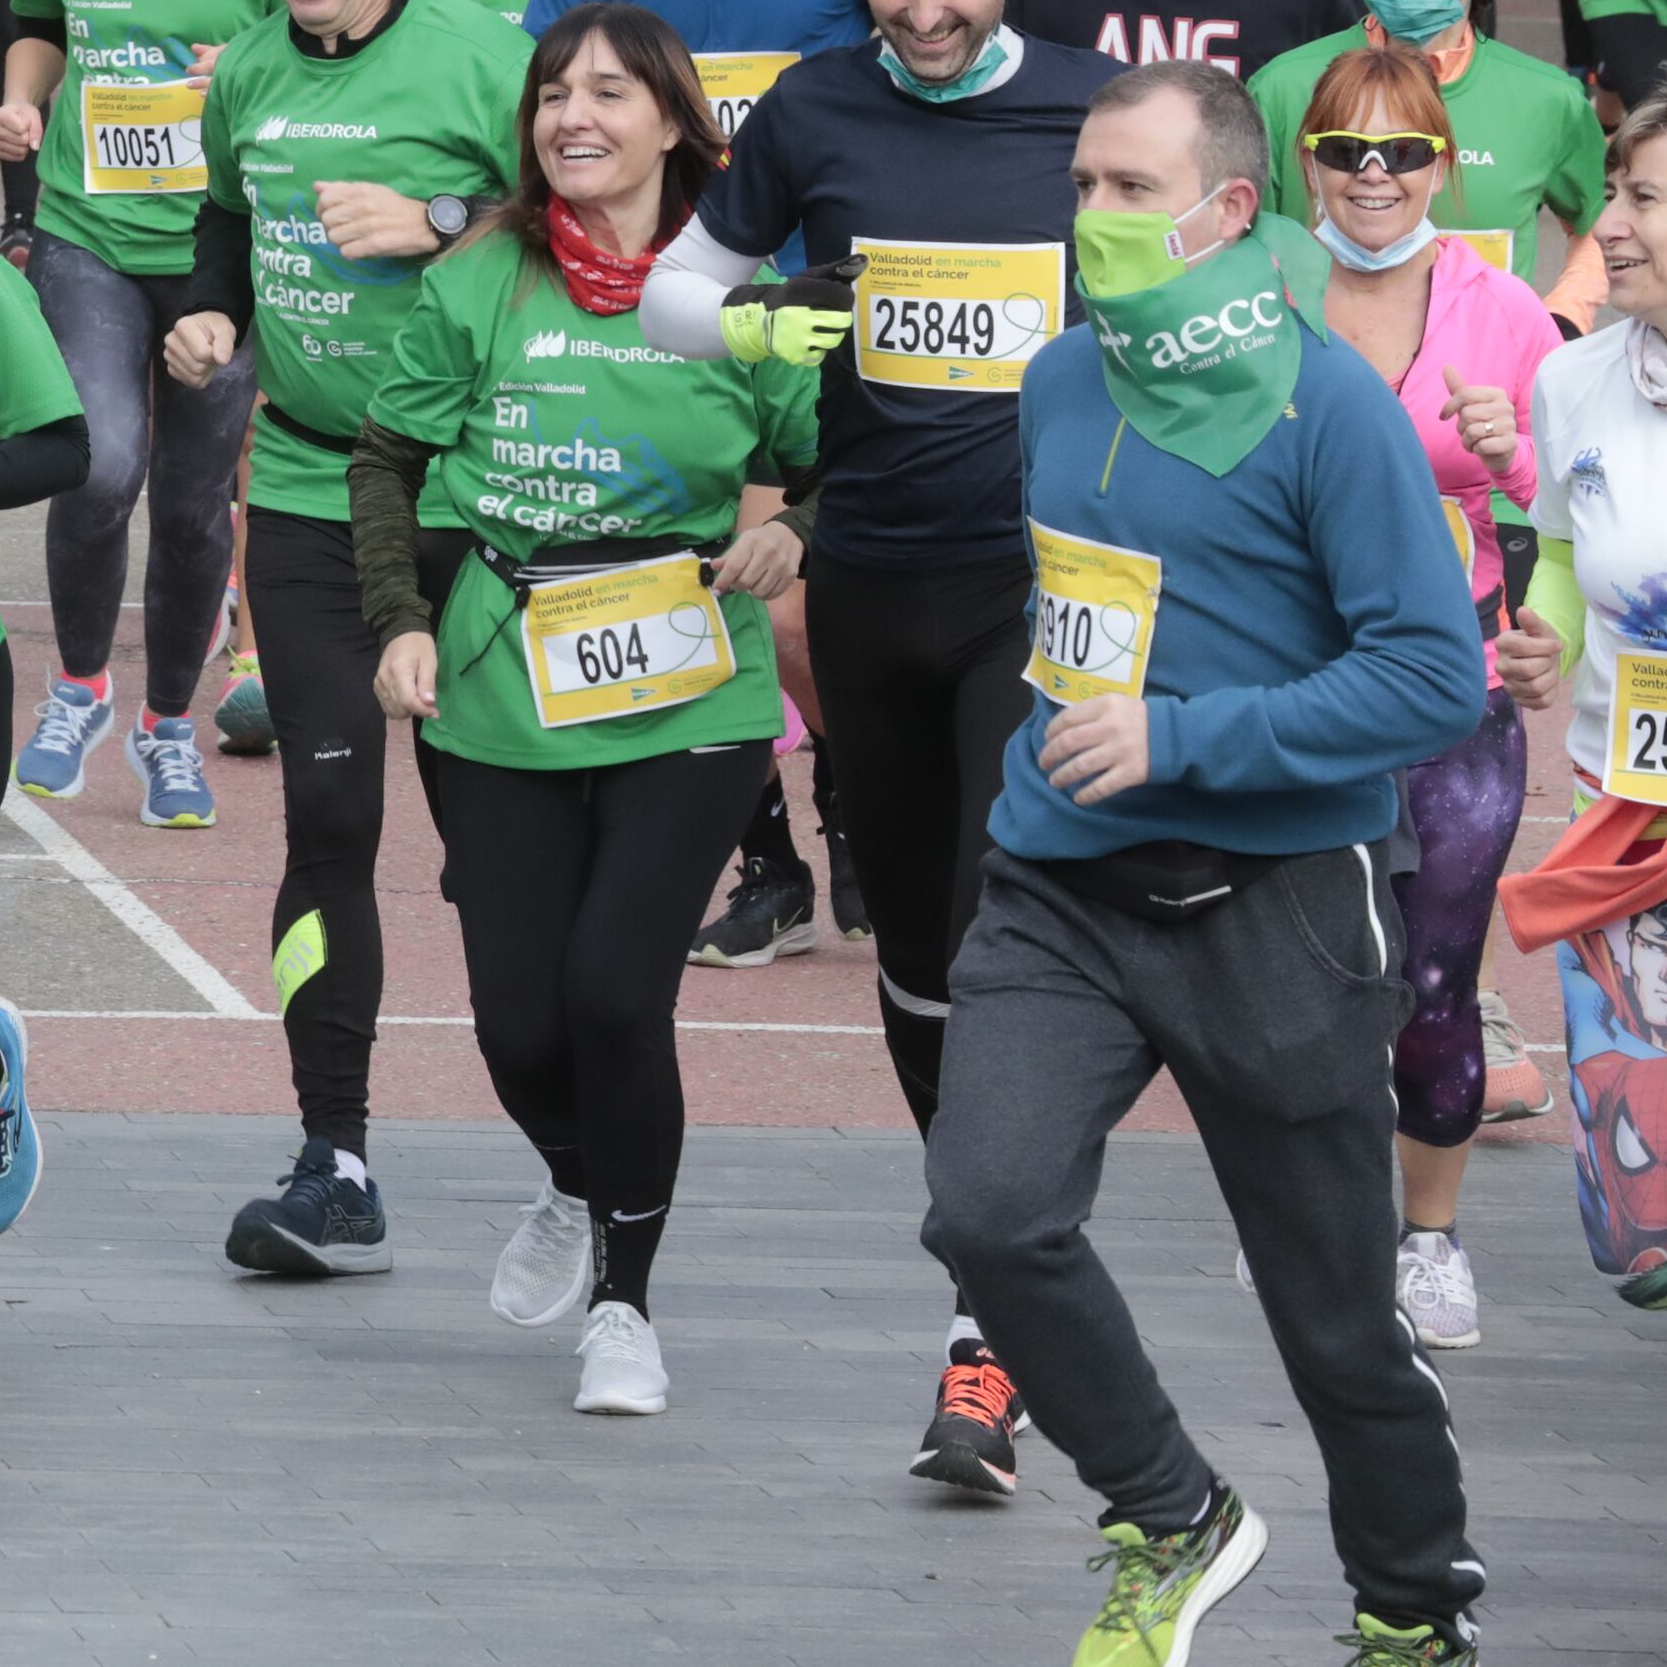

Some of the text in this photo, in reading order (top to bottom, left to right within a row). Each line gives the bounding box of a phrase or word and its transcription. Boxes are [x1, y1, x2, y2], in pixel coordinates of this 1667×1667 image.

[92, 0, 132, 10] Valladolid
[68, 13, 89, 39] En
[716, 61, 754, 72] marcha
[285, 122, 378, 141] IBERDROLA
[99, 126, 175, 167] 10051
[1458, 149, 1495, 166] OLA
[869, 265, 970, 281] contra el cáncer
[870, 252, 1002, 269] Valladolid en marcha
[265, 278, 356, 315] cáncer
[874, 297, 995, 357] 25849
[1144, 290, 1283, 370] aecc
[570, 339, 686, 364] IBERDROLA
[1179, 352, 1221, 375] Contra
[1225, 346, 1238, 363] el
[498, 381, 586, 395] Edición Valladolid
[493, 396, 529, 430] En
[492, 436, 622, 473] marcha
[484, 470, 598, 508] contra
[476, 492, 643, 536] el cáncer
[1067, 551, 1107, 570] marcha
[533, 573, 660, 607] Valladolid en marcha
[535, 591, 631, 620] contra el cáncer
[576, 622, 650, 686] 604
